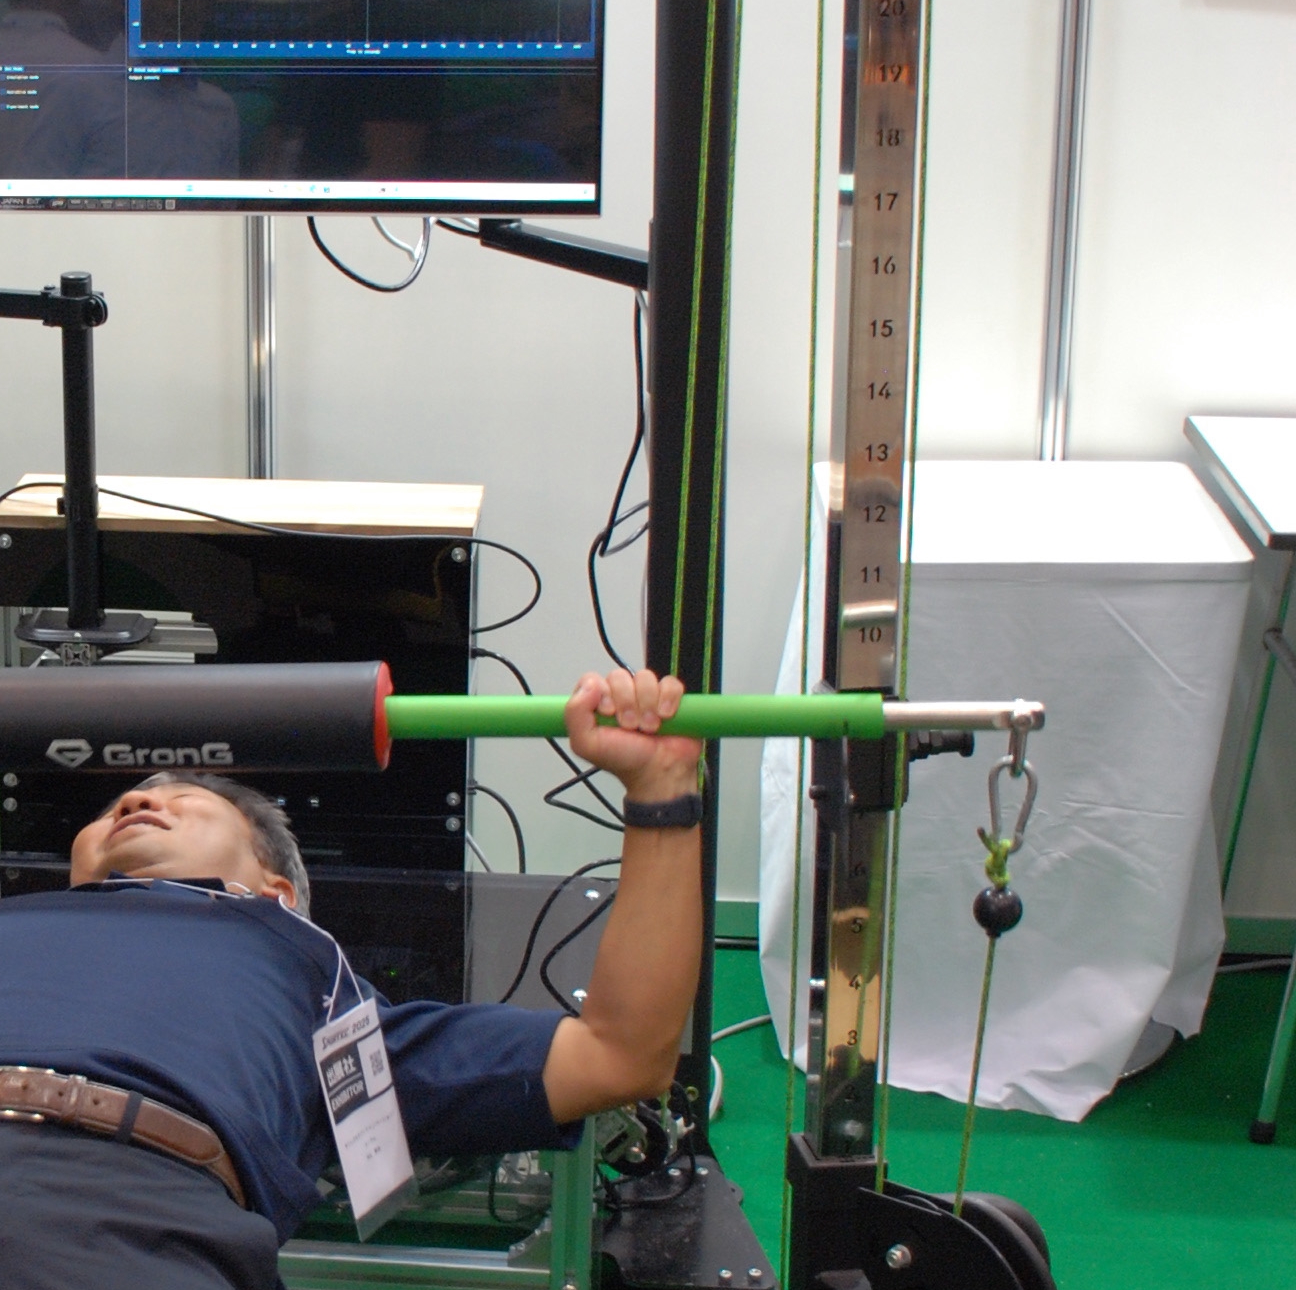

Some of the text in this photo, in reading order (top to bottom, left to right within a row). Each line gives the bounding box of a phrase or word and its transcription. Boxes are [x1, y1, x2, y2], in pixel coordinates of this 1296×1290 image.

[879, 0, 905, 18] 20
[878, 64, 902, 83] 19
[876, 128, 900, 147] 18
[874, 193, 898, 211] 17
[872, 256, 896, 275] 16
[870, 319, 894, 337] 15
[867, 382, 891, 400] 14
[865, 444, 889, 462] 13
[863, 506, 886, 523] 12
[860, 566, 881, 584] 11
[858, 627, 882, 644] 10
[851, 917, 863, 934] 5
[849, 974, 860, 990] 4
[847, 1030, 858, 1046] 3
